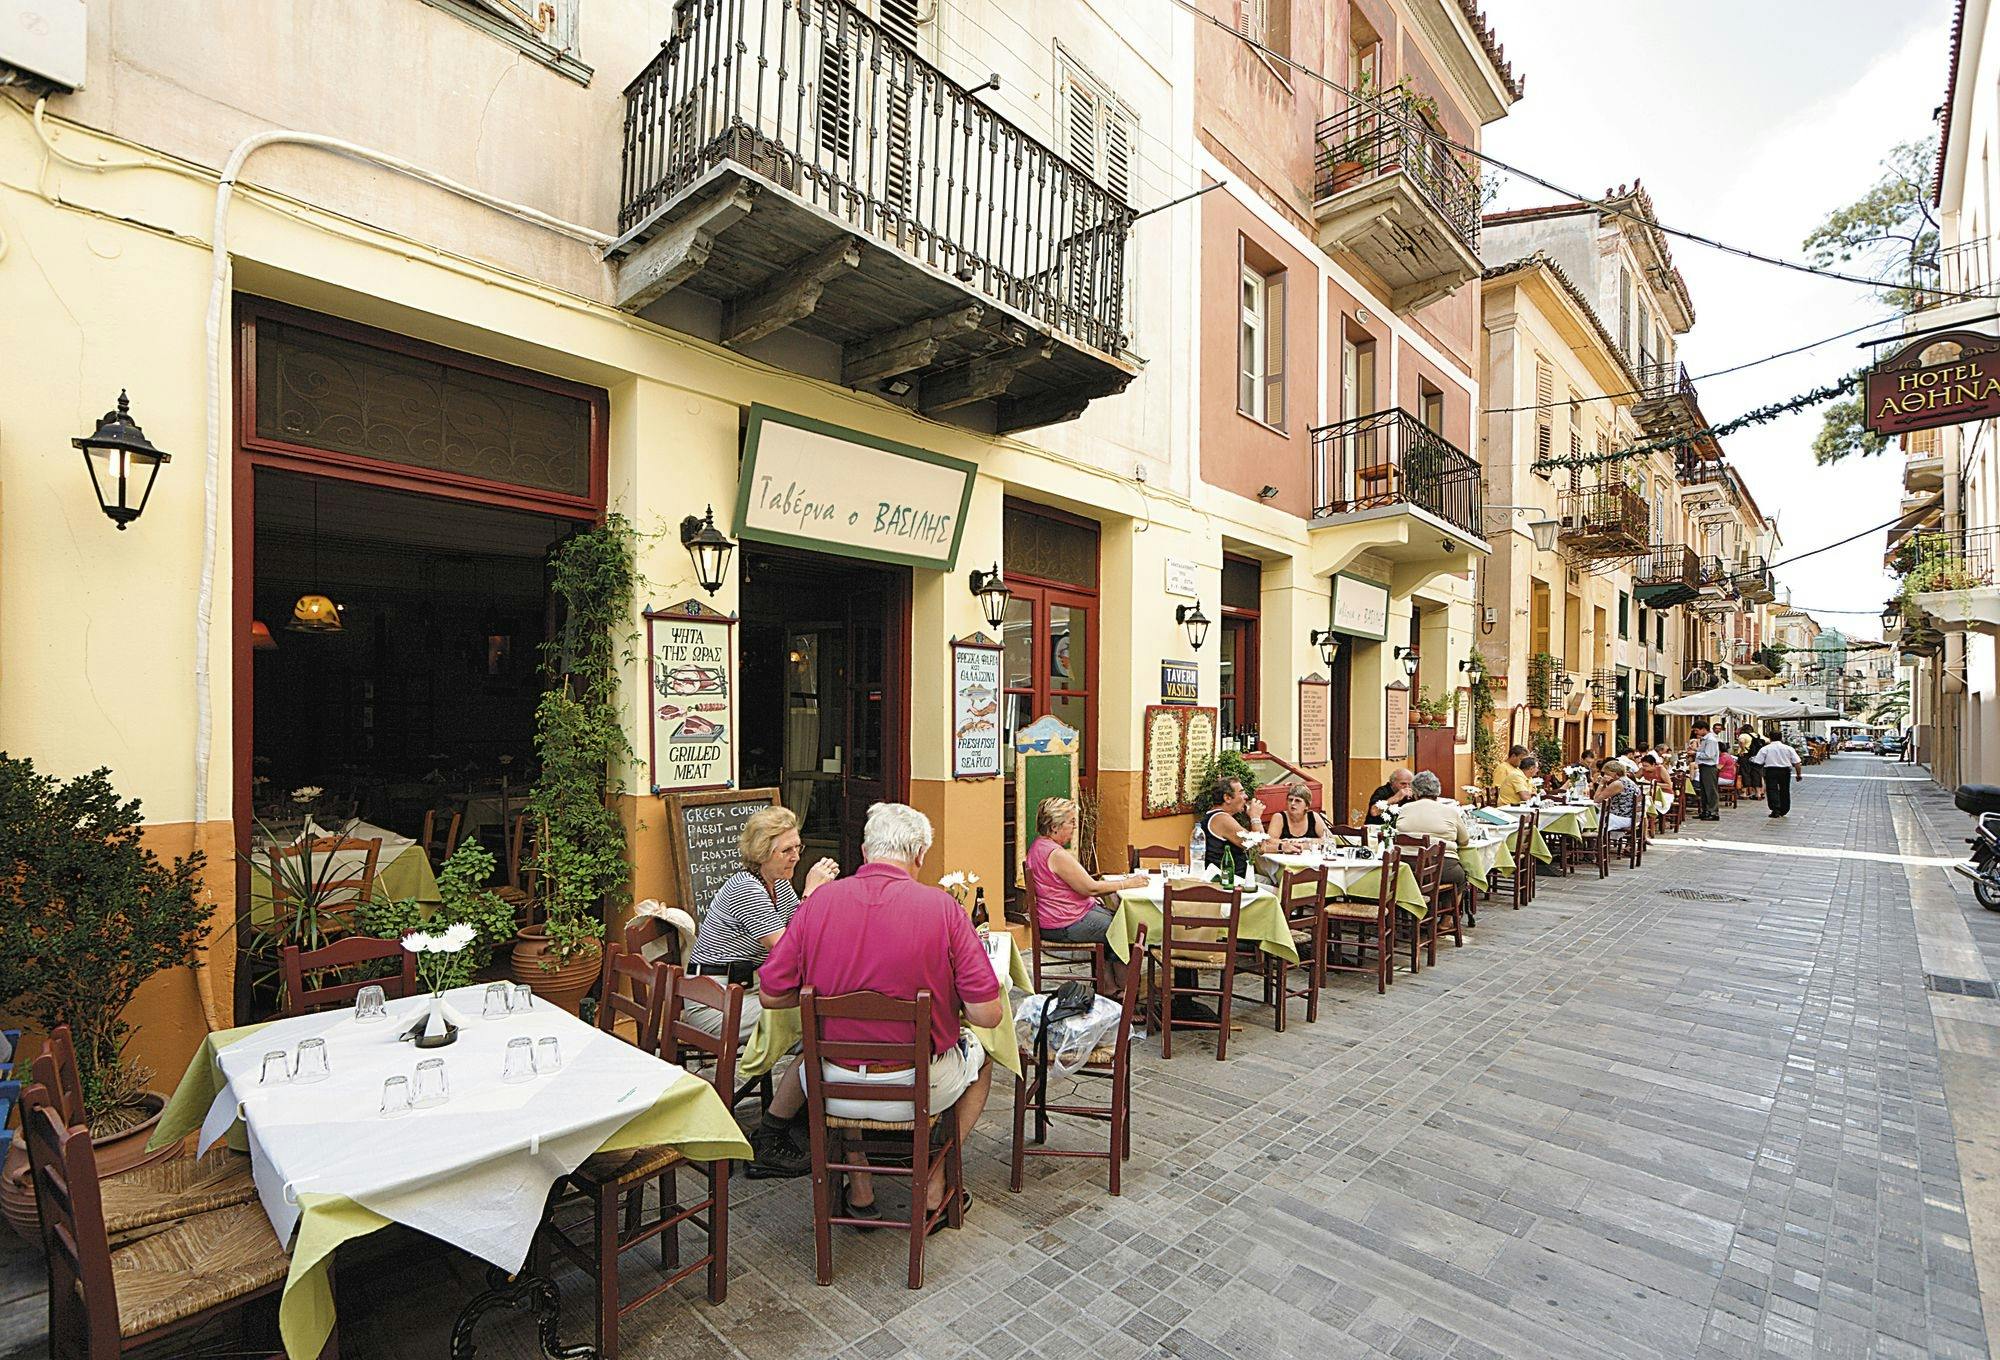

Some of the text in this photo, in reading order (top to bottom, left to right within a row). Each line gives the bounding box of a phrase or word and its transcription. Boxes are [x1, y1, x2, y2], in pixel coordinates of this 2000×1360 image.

[1899, 363, 1983, 392] HOTEL
[1876, 378, 2000, 418] ΑΘΗΝΑ
[760, 475, 835, 530] Ταβέρνα
[873, 502, 951, 545] ΒΑΣΙΛΗΣ
[671, 627, 704, 644] ΨΗΤΑ
[662, 645, 722, 662] ΤΗΣ ΩΡΑΣ
[1166, 669, 1196, 684] TAVERN
[1166, 683, 1196, 698] VASILIS
[958, 737, 996, 749] FRESH FISH
[669, 745, 721, 762] GRILLED
[673, 763, 712, 781] MEAT
[686, 807, 725, 823] GREEK
[688, 838, 714, 849] LAMB
[716, 836, 725, 845] IN
[690, 862, 717, 875] BEEF
